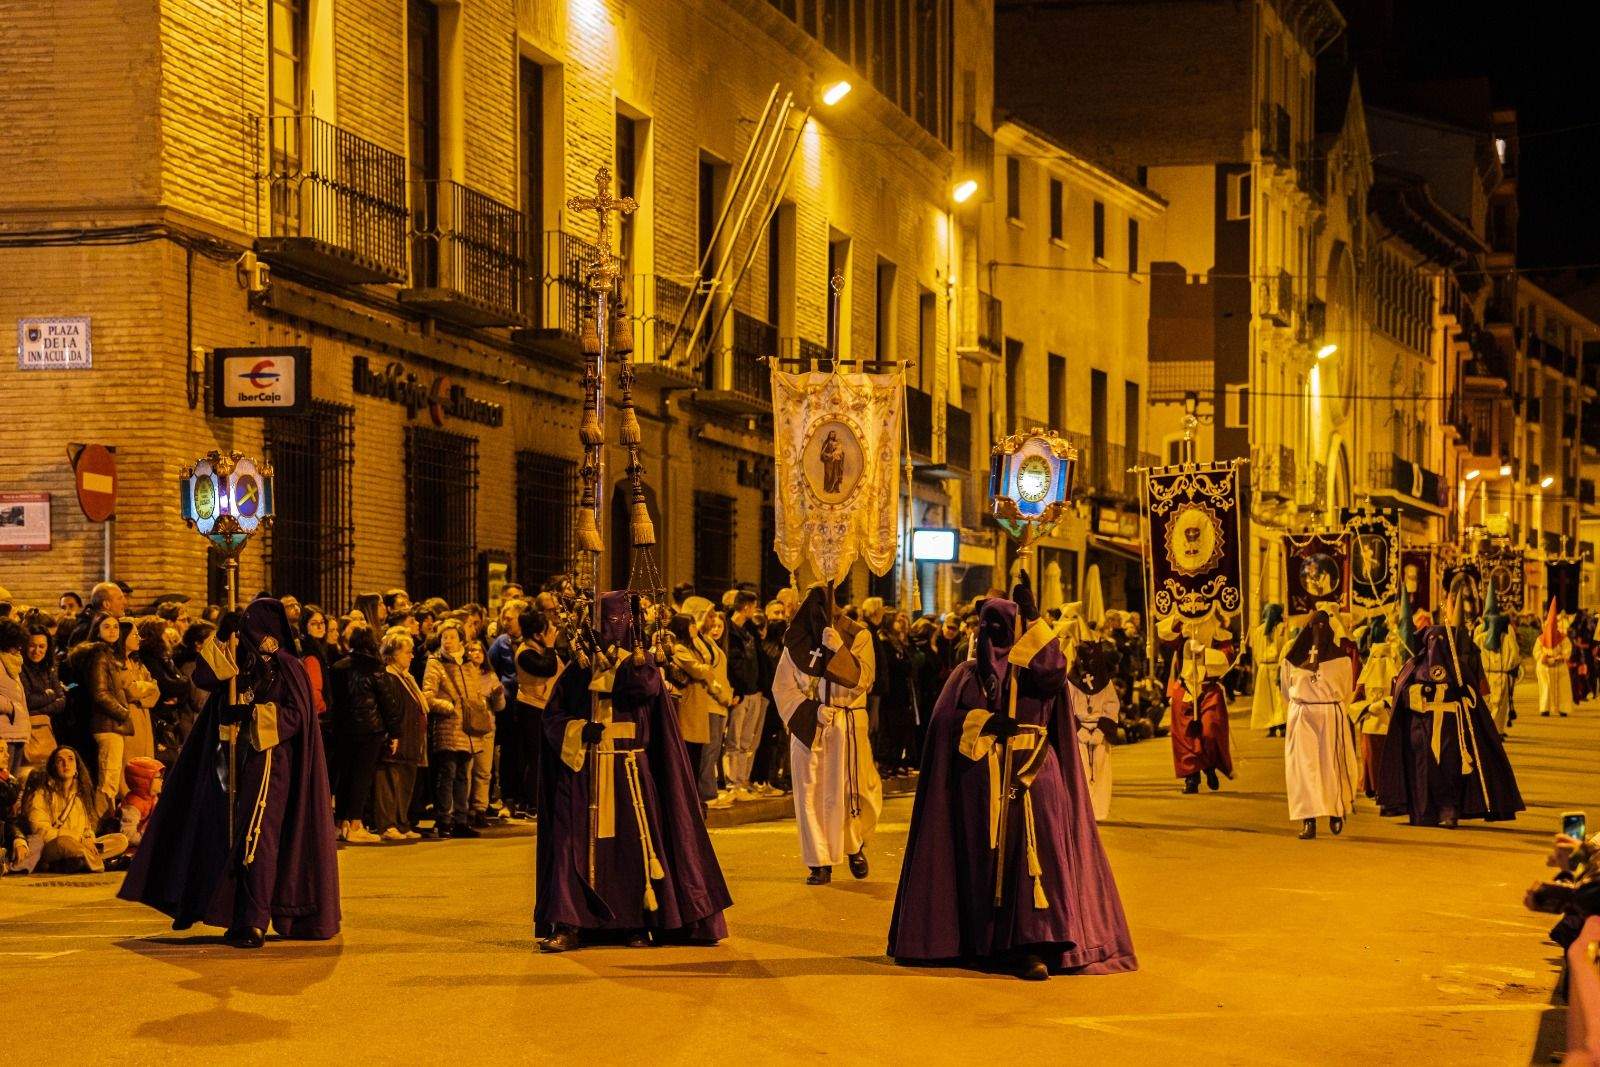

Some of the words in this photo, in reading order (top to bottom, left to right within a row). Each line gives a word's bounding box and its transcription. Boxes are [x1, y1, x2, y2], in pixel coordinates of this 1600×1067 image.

[48, 325, 79, 336] PLAZA
[43, 338, 60, 349] DE
[63, 337, 77, 349] LA
[238, 392, 281, 404] iberCaja
